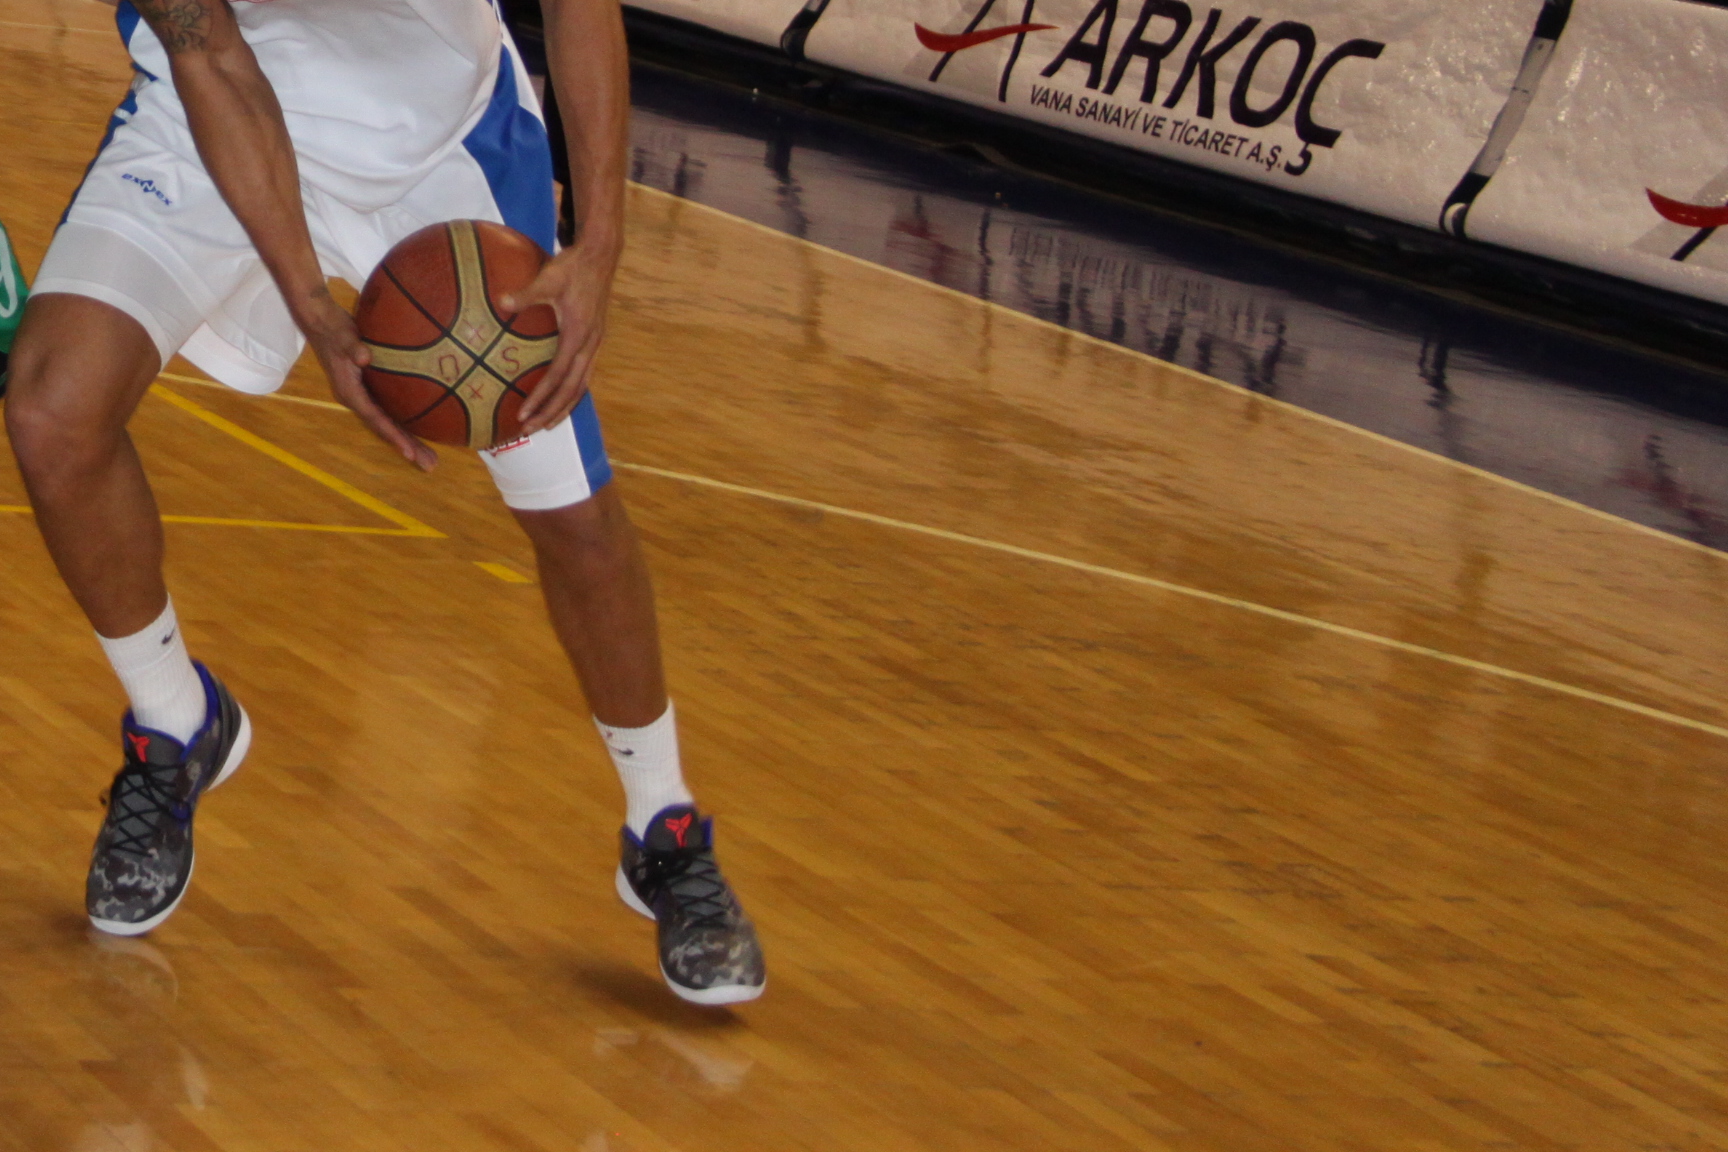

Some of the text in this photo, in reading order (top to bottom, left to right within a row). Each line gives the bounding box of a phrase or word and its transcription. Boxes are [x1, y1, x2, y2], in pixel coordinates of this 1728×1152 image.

[1030, 85, 1073, 116] VANA
[1075, 96, 1141, 131] SANAYİ
[1140, 111, 1166, 138] VE
[1171, 117, 1251, 157] TİCARET
